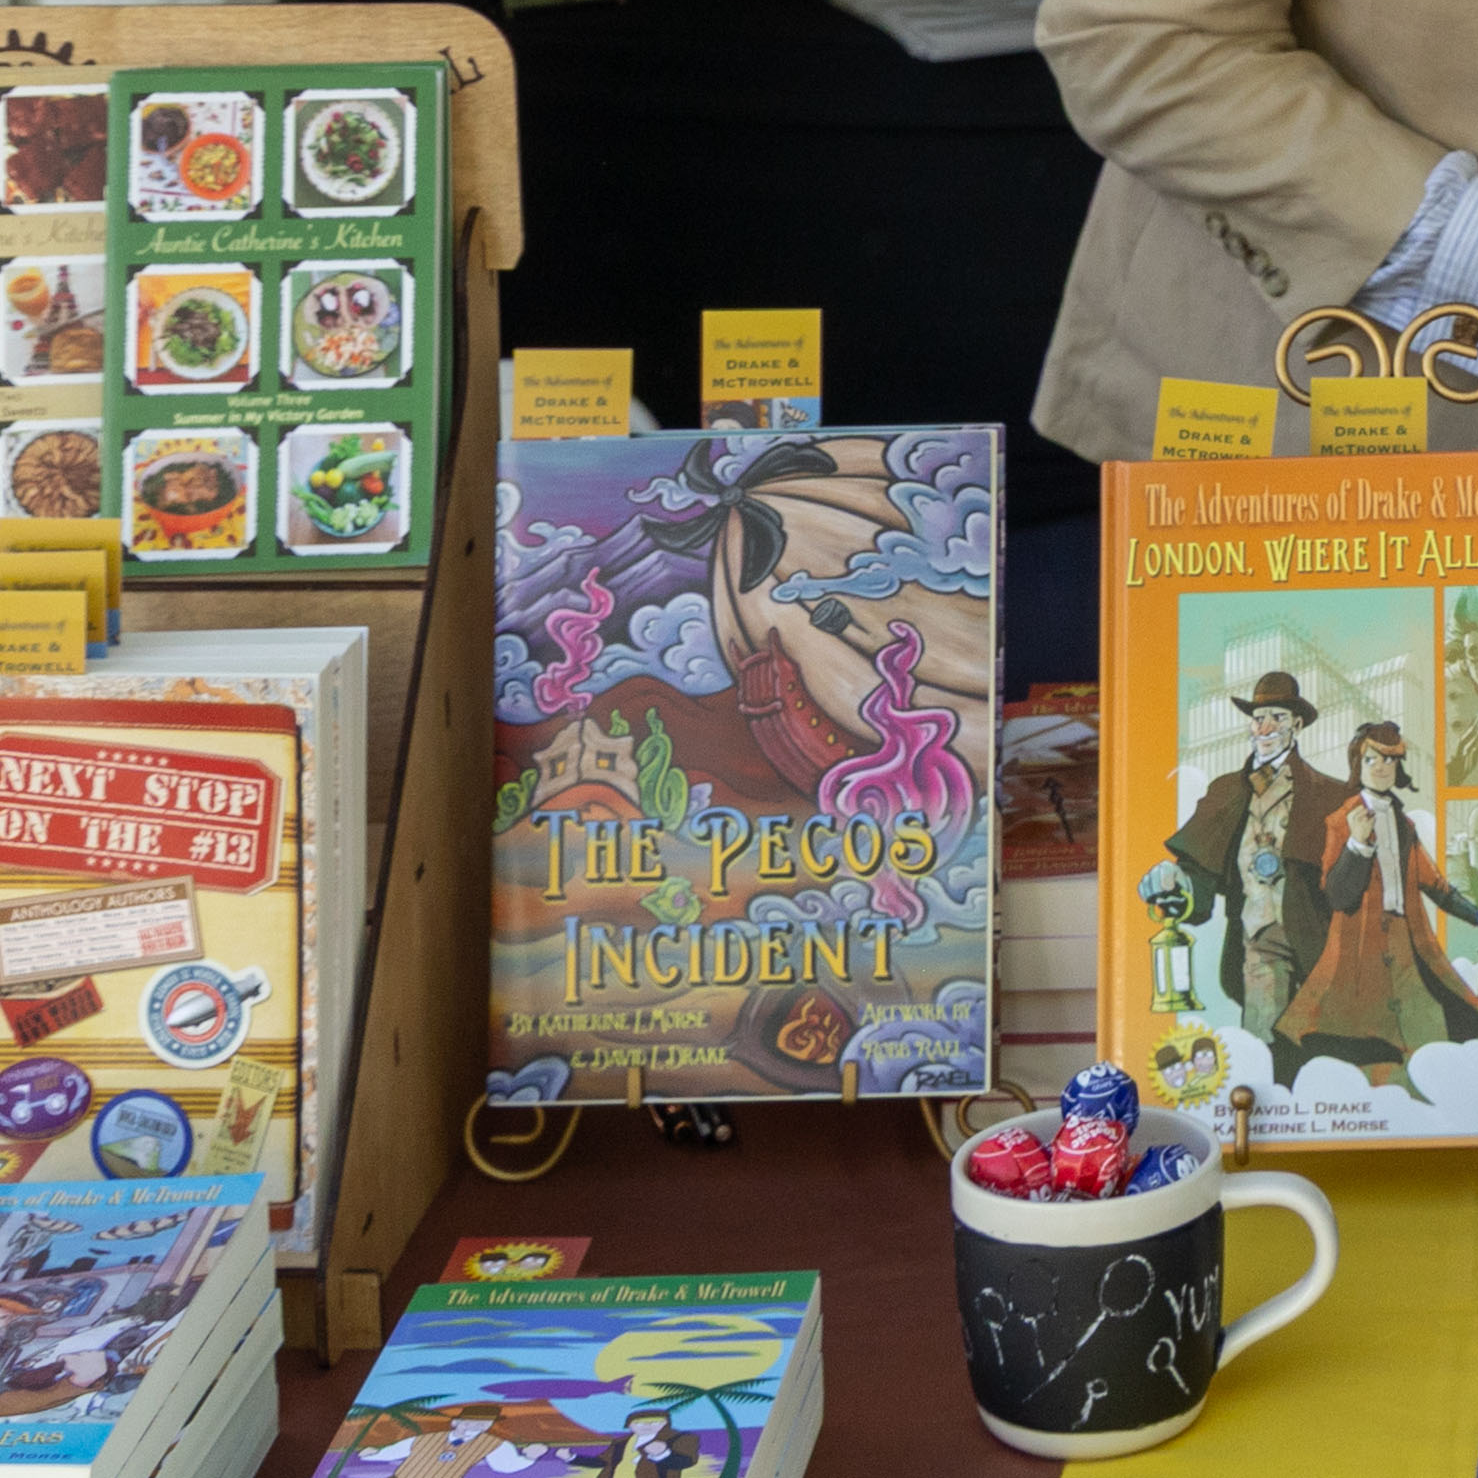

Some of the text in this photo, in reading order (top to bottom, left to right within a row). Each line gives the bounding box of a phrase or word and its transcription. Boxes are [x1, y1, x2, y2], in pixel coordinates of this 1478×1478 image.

[135, 222, 403, 257] Auntie Catherine's Kitchen
[725, 359, 800, 371] DRAKE &
[227, 394, 313, 408] Volume Three
[534, 396, 608, 408] DRAKE &
[173, 411, 223, 425] Summer
[316, 407, 365, 421] Garden
[1177, 428, 1253, 446] DRAKE &
[1333, 425, 1408, 439] DRAKE &
[1144, 483, 1187, 529] The
[1195, 479, 1320, 527] Adventures
[1326, 477, 1352, 522] of
[1355, 479, 1423, 522] Drake
[1430, 478, 1447, 520] &
[1126, 535, 1255, 586] LONDON,
[1263, 532, 1370, 582] WHERE
[1378, 529, 1412, 579] IT
[48, 643, 61, 653] &
[0, 755, 259, 818] NEXT STOP
[0, 808, 252, 866] ON THE #13
[532, 805, 940, 903] THE PECOS
[9, 886, 178, 922] ANTHOLOGY AUTHORS
[562, 915, 908, 1007] INCIDENT
[508, 1013, 536, 1038] BY
[538, 1008, 632, 1036] KATHERINE
[649, 1008, 709, 1032] MORSE
[860, 1002, 973, 1029] ARTWORK BY
[588, 1046, 648, 1071] DAVID
[665, 1046, 730, 1068] DRAKE
[862, 1039, 967, 1063] ROBB RAEL
[1214, 1102, 1236, 1119] BY
[1293, 1102, 1311, 1116] L.
[1314, 1100, 1373, 1116] DRAKE
[1212, 1118, 1390, 1136] KAHERINE L. MORSE
[24, 1184, 224, 1208] of Drake & McTrowell
[446, 1280, 788, 1307] The Adventures of Drake & McTrowell
[0, 1428, 65, 1448] EARS
